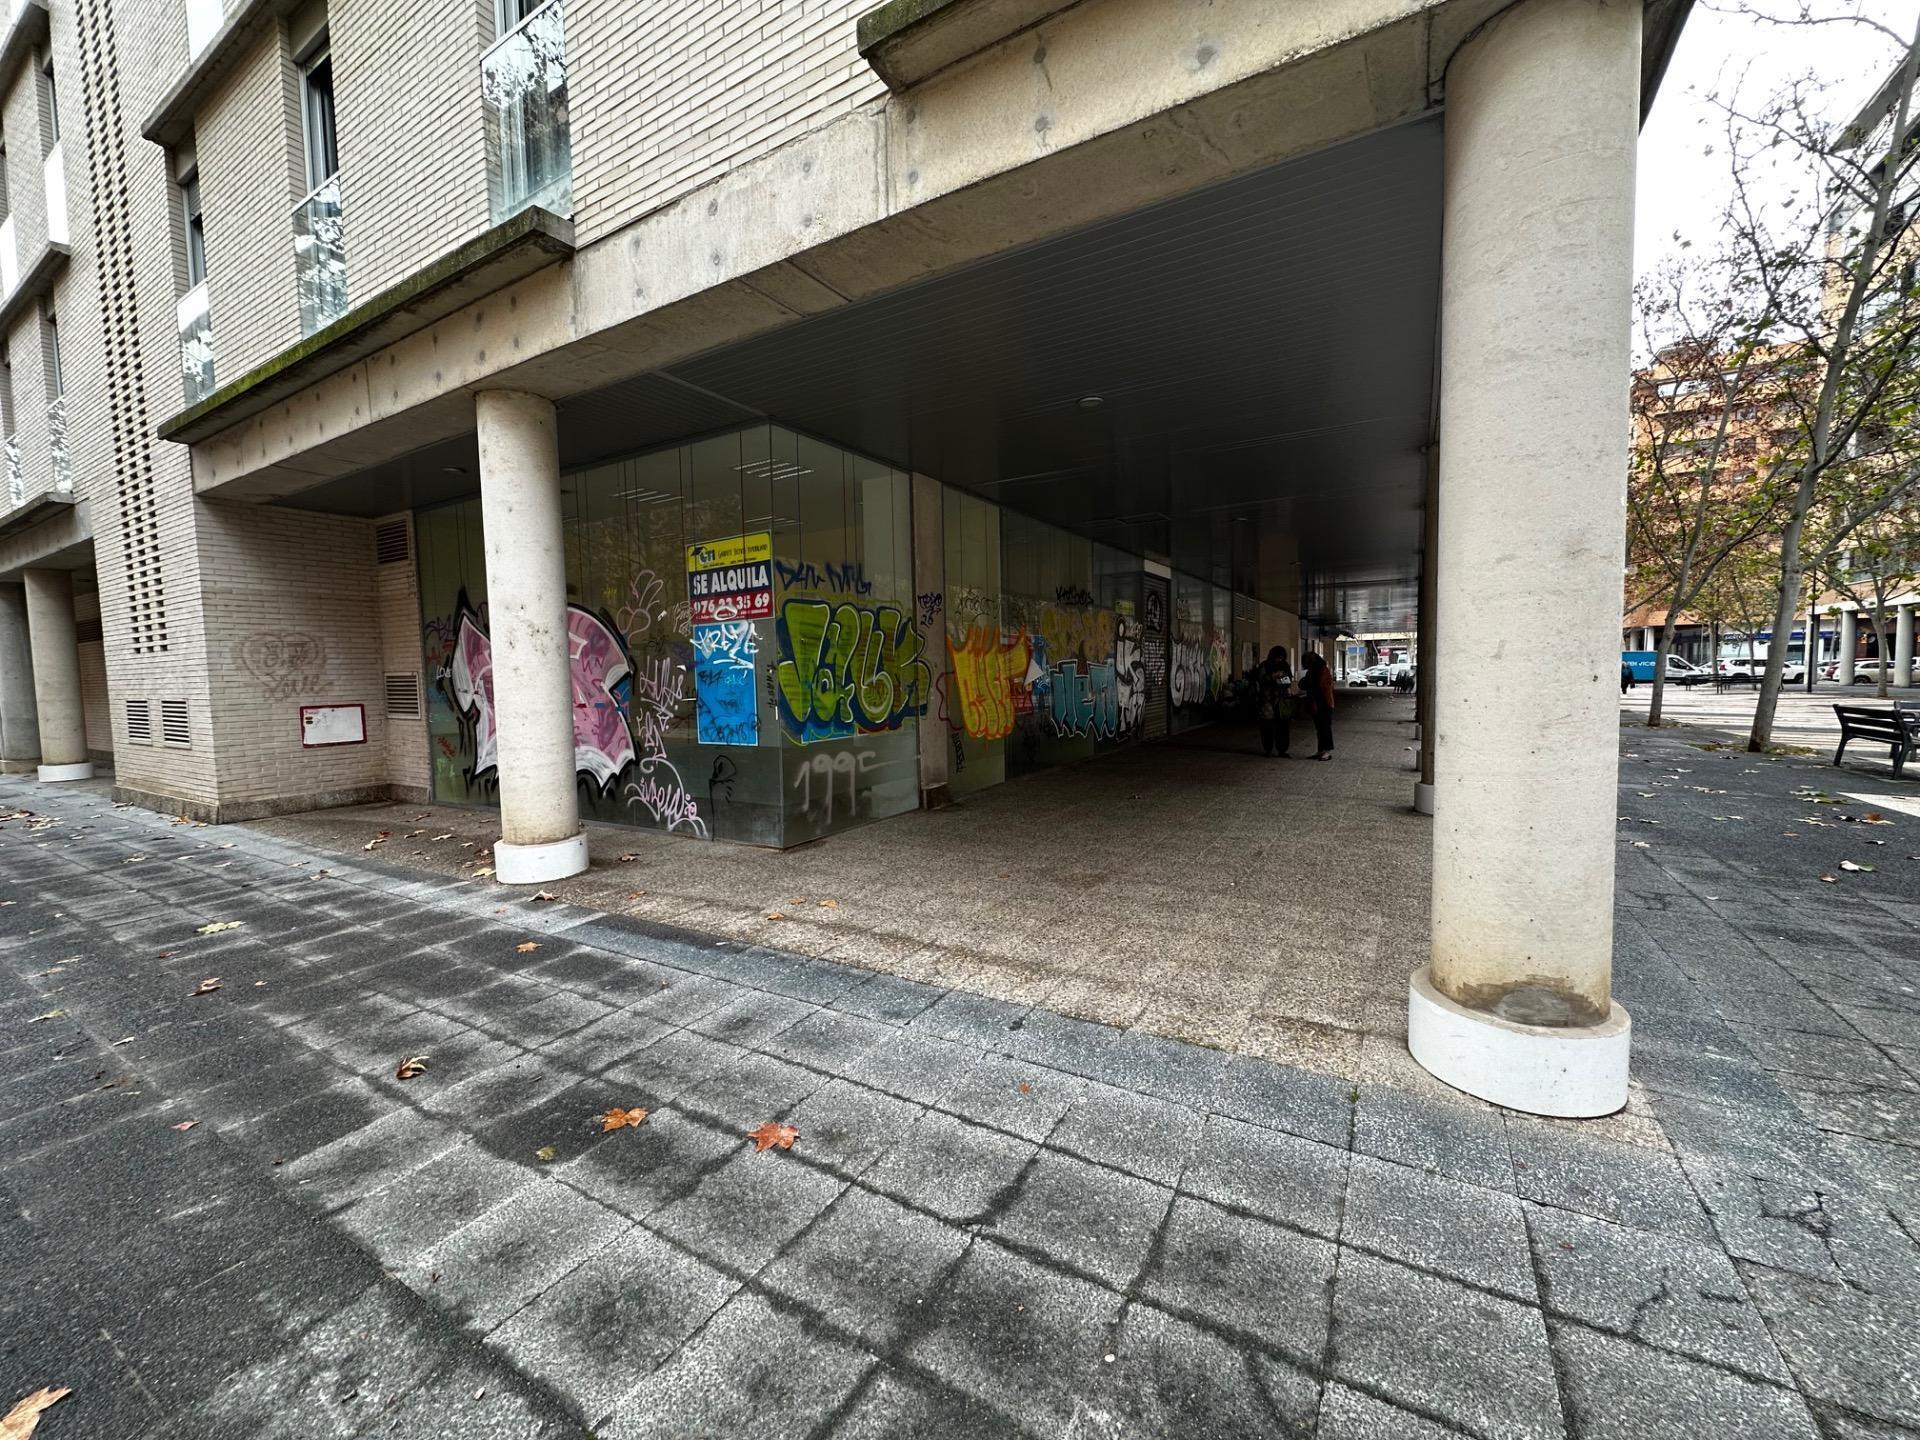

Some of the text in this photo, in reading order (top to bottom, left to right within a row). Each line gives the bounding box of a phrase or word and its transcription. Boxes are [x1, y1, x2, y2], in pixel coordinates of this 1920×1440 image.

[693, 573, 708, 595] SE
[711, 565, 769, 592] ALQUILA
[693, 599, 715, 614] 976
[754, 592, 770, 608] 69
